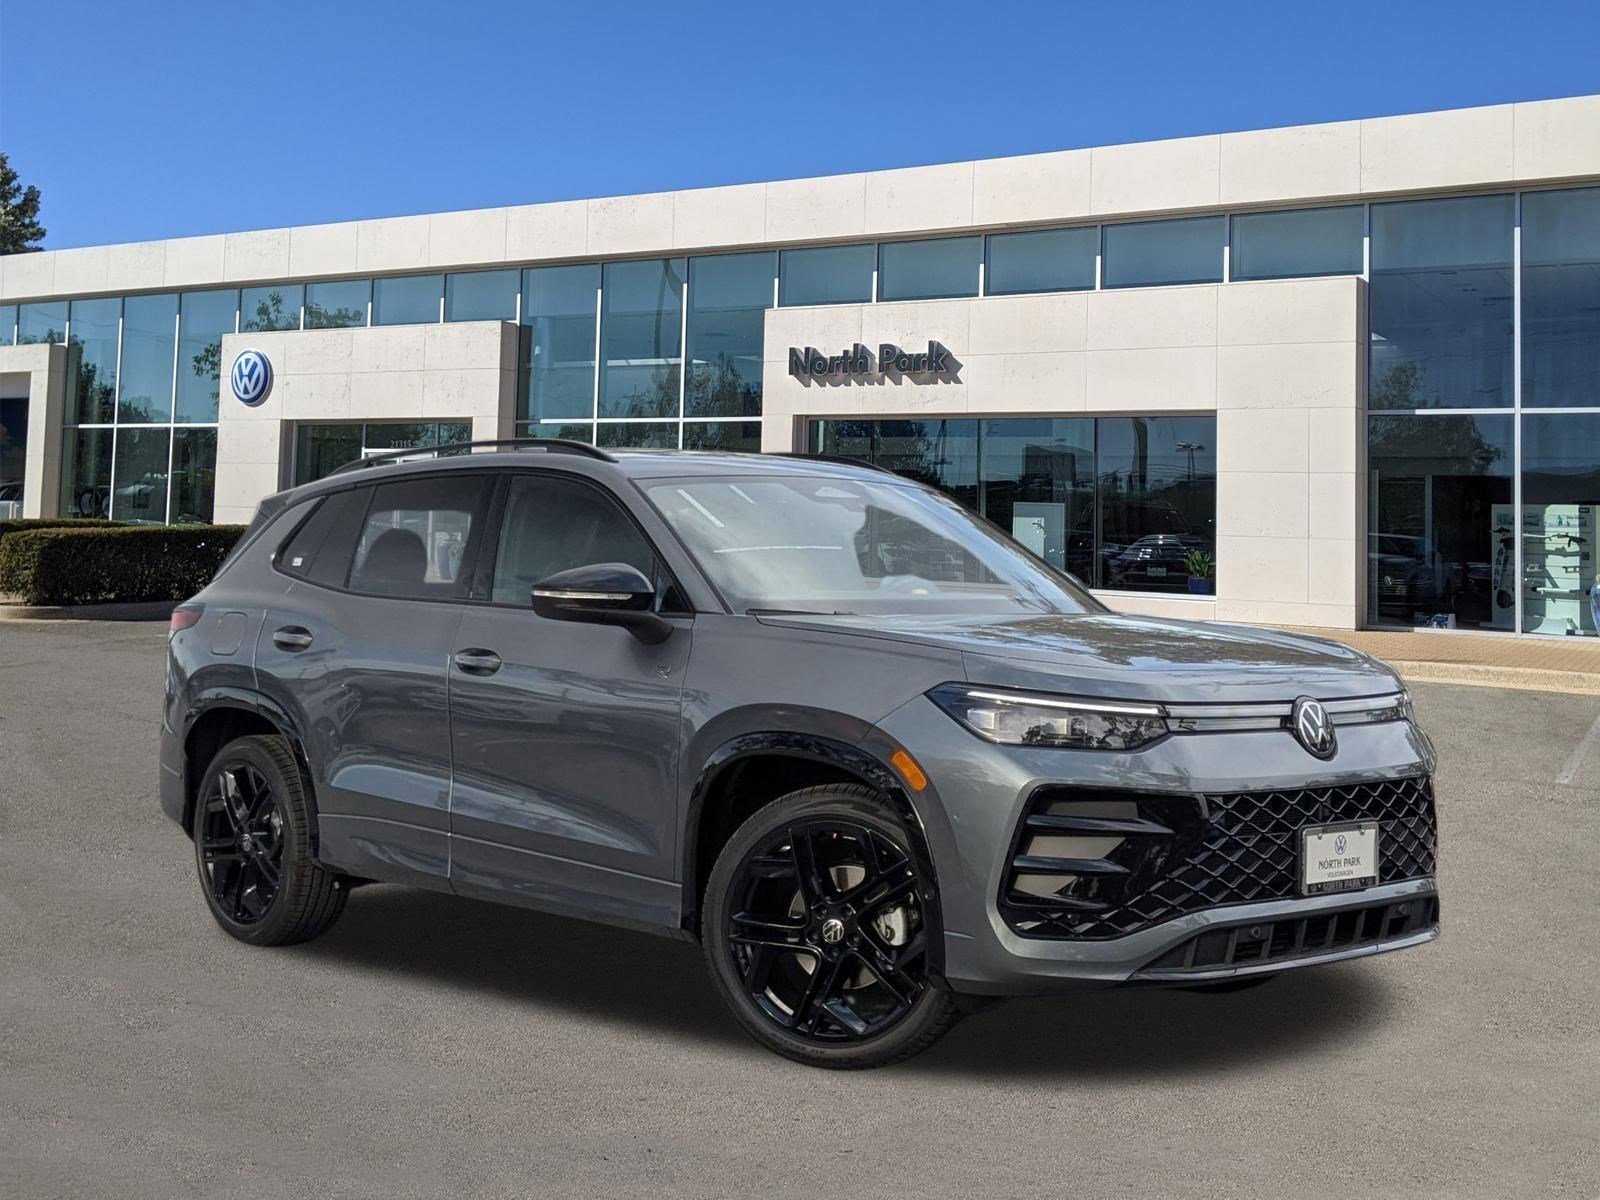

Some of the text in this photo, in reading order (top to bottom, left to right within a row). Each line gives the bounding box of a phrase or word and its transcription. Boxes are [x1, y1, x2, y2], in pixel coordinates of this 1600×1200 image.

[788, 340, 948, 376] North Park
[1318, 856, 1362, 870] NORTH PARK
